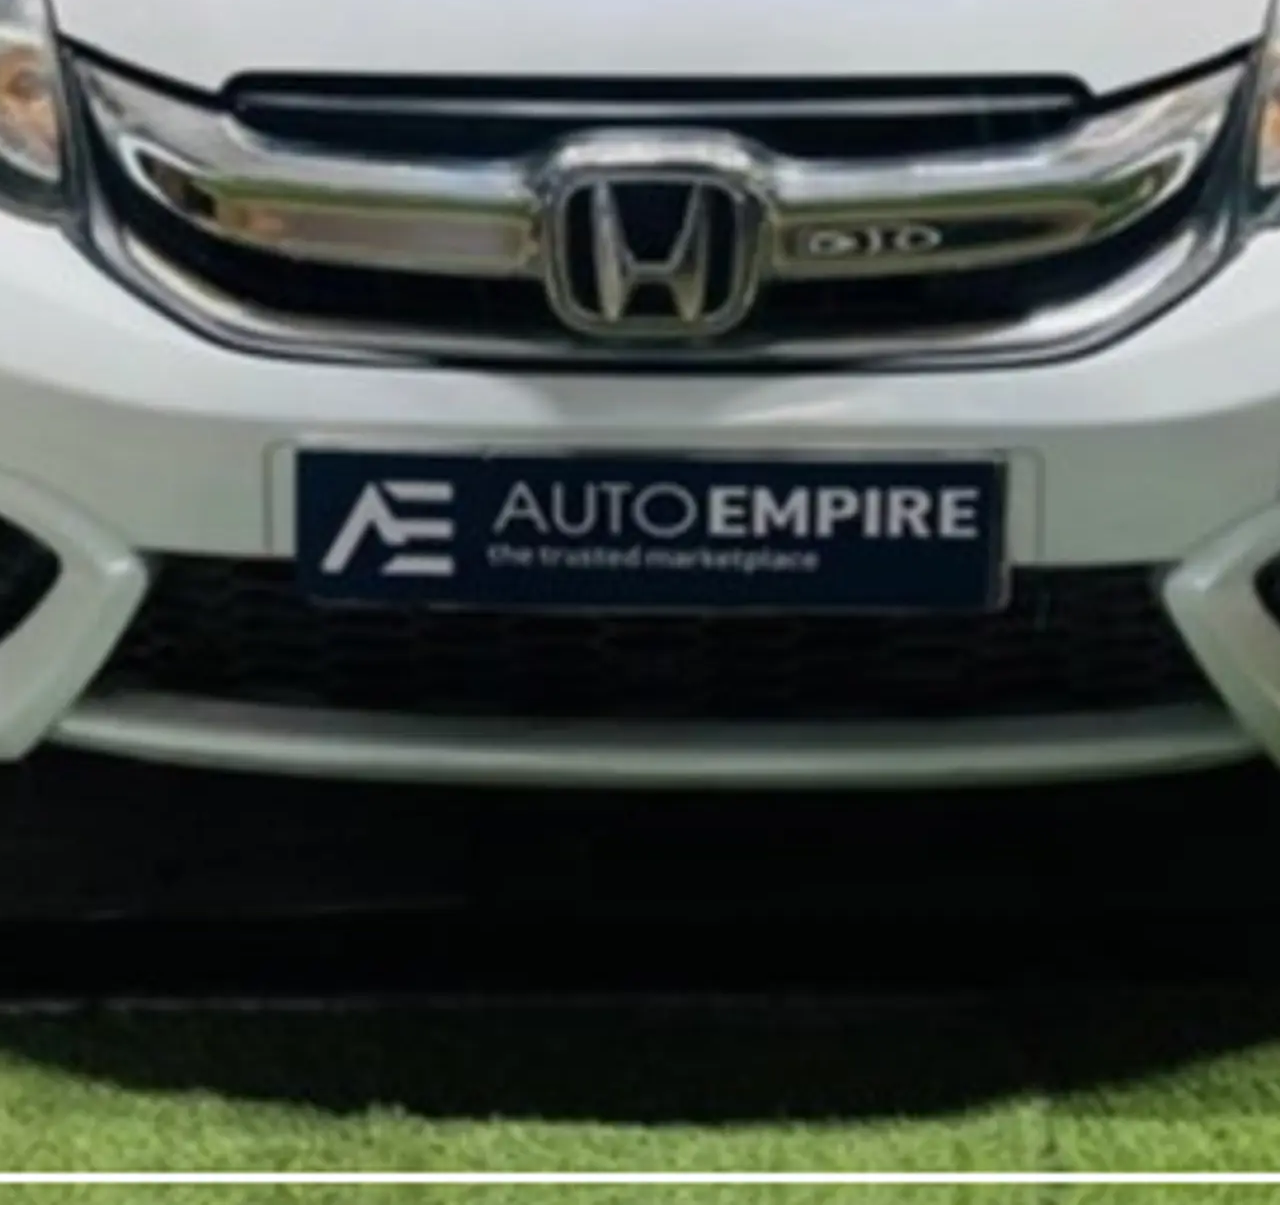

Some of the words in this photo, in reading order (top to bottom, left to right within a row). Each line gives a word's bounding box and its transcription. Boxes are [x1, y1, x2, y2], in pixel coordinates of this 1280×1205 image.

[486, 544, 532, 567] the
[539, 544, 642, 568] trusted
[645, 546, 820, 572] marketplace
